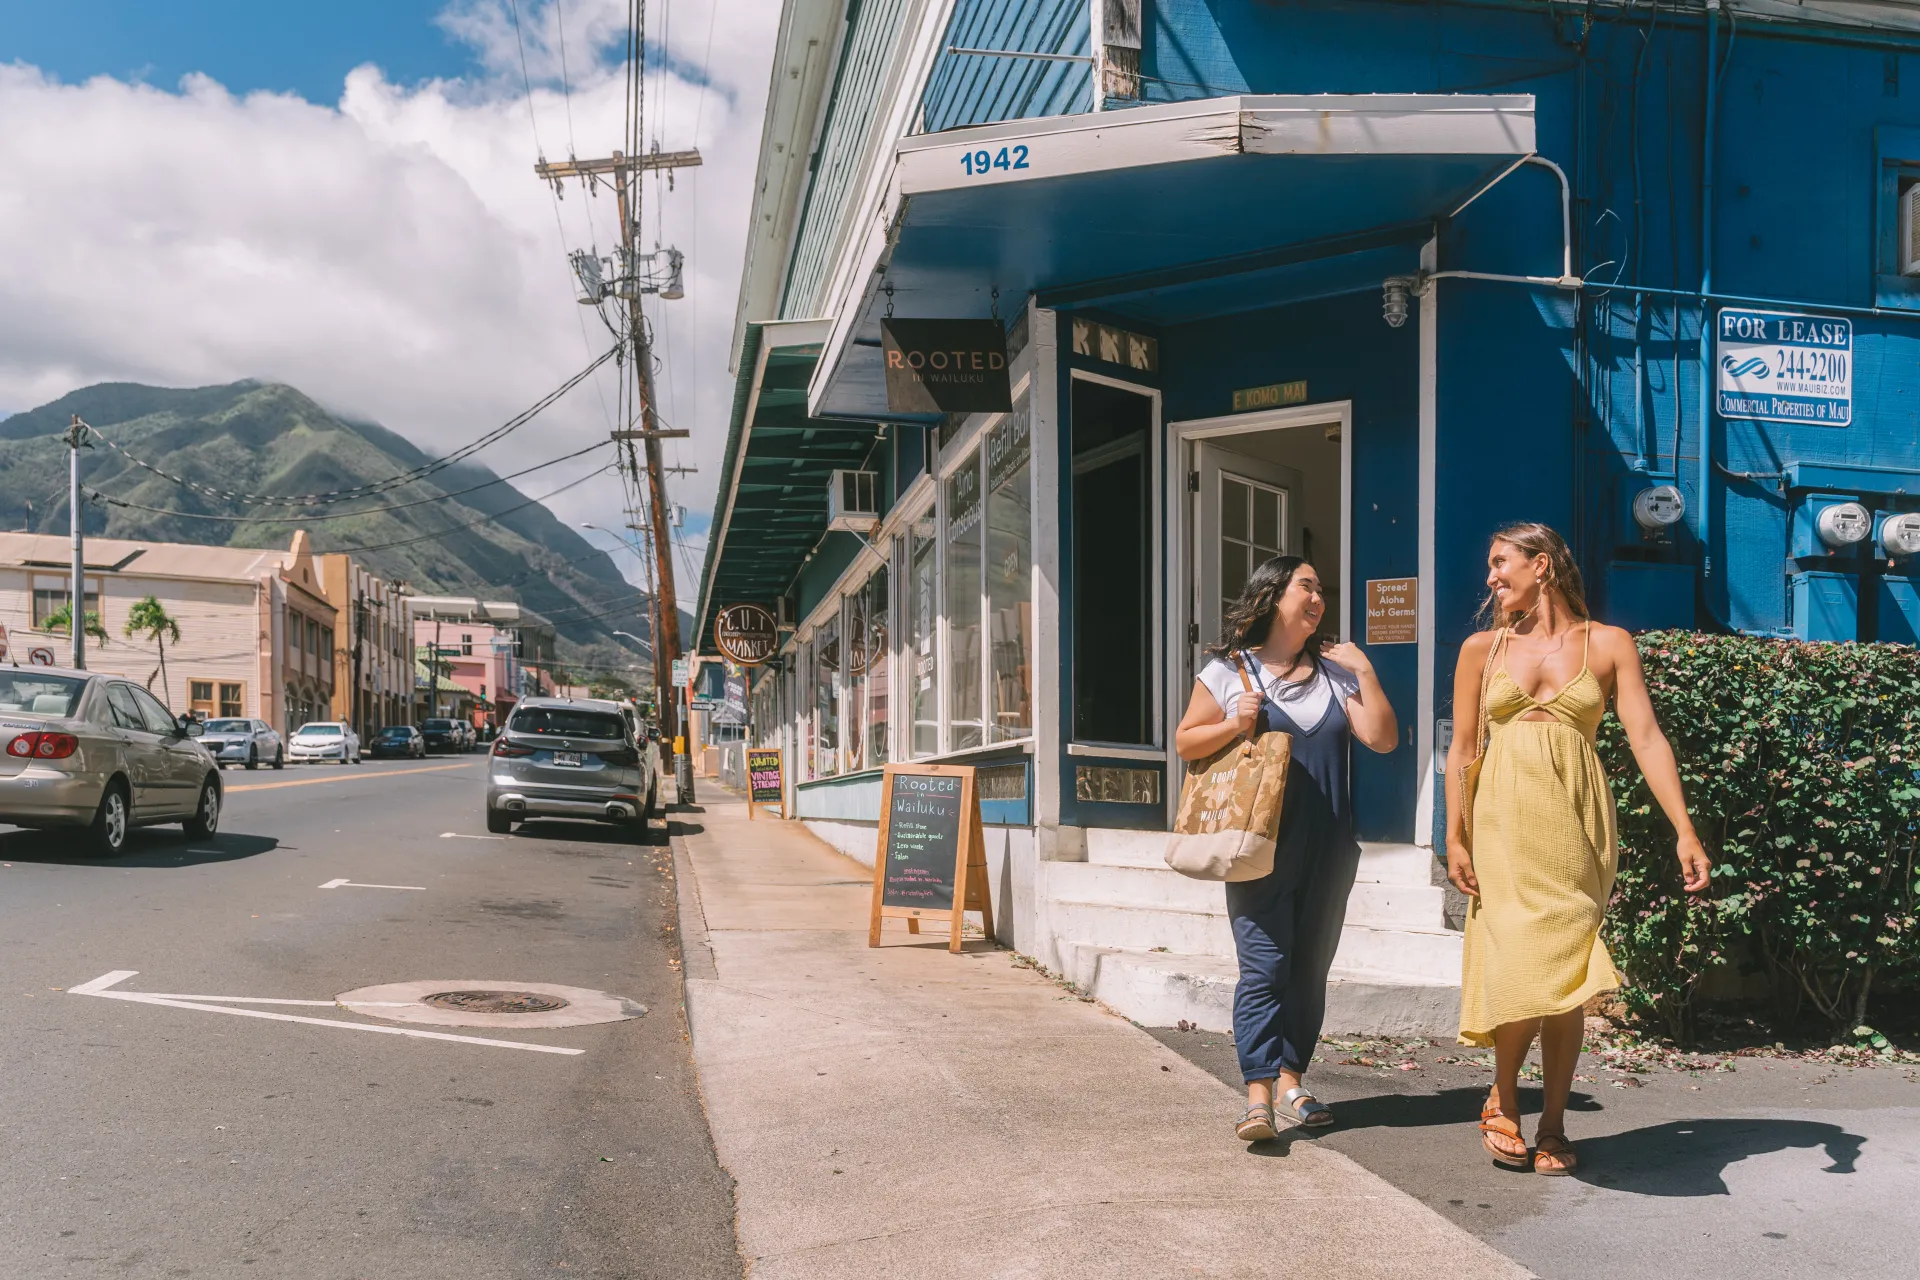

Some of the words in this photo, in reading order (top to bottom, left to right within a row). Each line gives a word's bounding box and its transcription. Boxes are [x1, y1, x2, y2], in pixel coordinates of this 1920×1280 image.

[960, 144, 1030, 176] 1942
[1723, 315, 1767, 340] FOR
[1777, 320, 1847, 346] LEASE
[887, 350, 1005, 370] ROOTED
[1776, 349, 1847, 384] 244-2200
[912, 373, 924, 383] IN
[930, 373, 984, 383] WAILUKU
[1234, 391, 1241, 409] E
[1246, 387, 1279, 407] KOMO
[1283, 382, 1307, 404] MAI
[1776, 381, 1846, 396] WWW.MAUIBIZ.COM
[1719, 394, 1769, 415] COMMERCIAL
[1816, 404, 1826, 418] OF
[1828, 401, 1849, 420] MAUI
[990, 418, 1012, 469] Refill
[1013, 407, 1030, 446] Bar
[1004, 550, 1018, 578] OPEN
[1376, 582, 1408, 595] Spread
[1379, 595, 1405, 605] Aloha
[1368, 608, 1386, 618] Not
[1388, 607, 1416, 617] Germs
[726, 638, 768, 658] MARKET
[917, 656, 934, 676] ROOTED
[750, 756, 779, 767] CURATED
[751, 770, 780, 781] VINTAGE
[899, 775, 954, 792] Rooted
[896, 799, 945, 817] Wailuku
